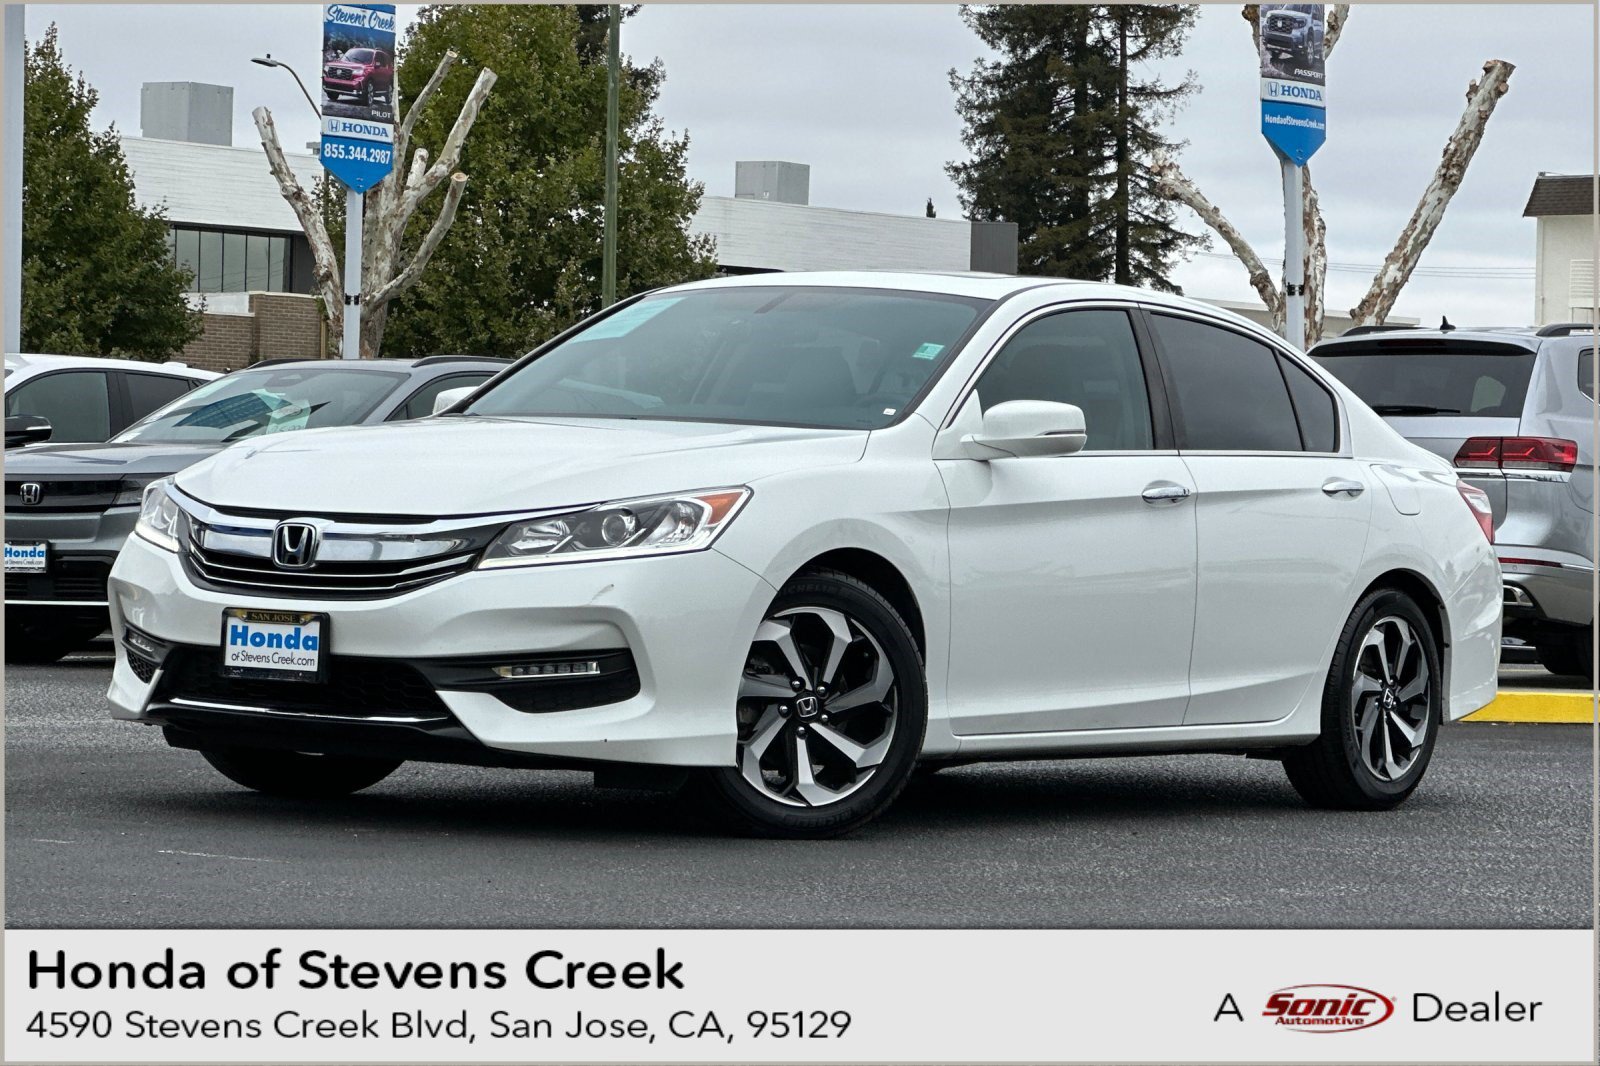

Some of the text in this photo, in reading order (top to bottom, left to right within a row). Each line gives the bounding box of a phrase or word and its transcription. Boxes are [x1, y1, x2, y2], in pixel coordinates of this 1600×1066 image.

[326, 4, 395, 31] Stevens Creek
[1294, 68, 1324, 79] PASSPORT
[1281, 85, 1322, 101] HONDA
[371, 109, 391, 118] PILOT
[342, 122, 389, 137] HONDA
[1264, 114, 1325, 130] HondaofStevensCreek.com
[324, 143, 391, 164] 855.344.2987
[5, 547, 45, 557] Honda
[251, 612, 295, 622] SAN JOSE
[230, 625, 318, 651] Honda
[231, 650, 315, 666] of Stevens Creek.com
